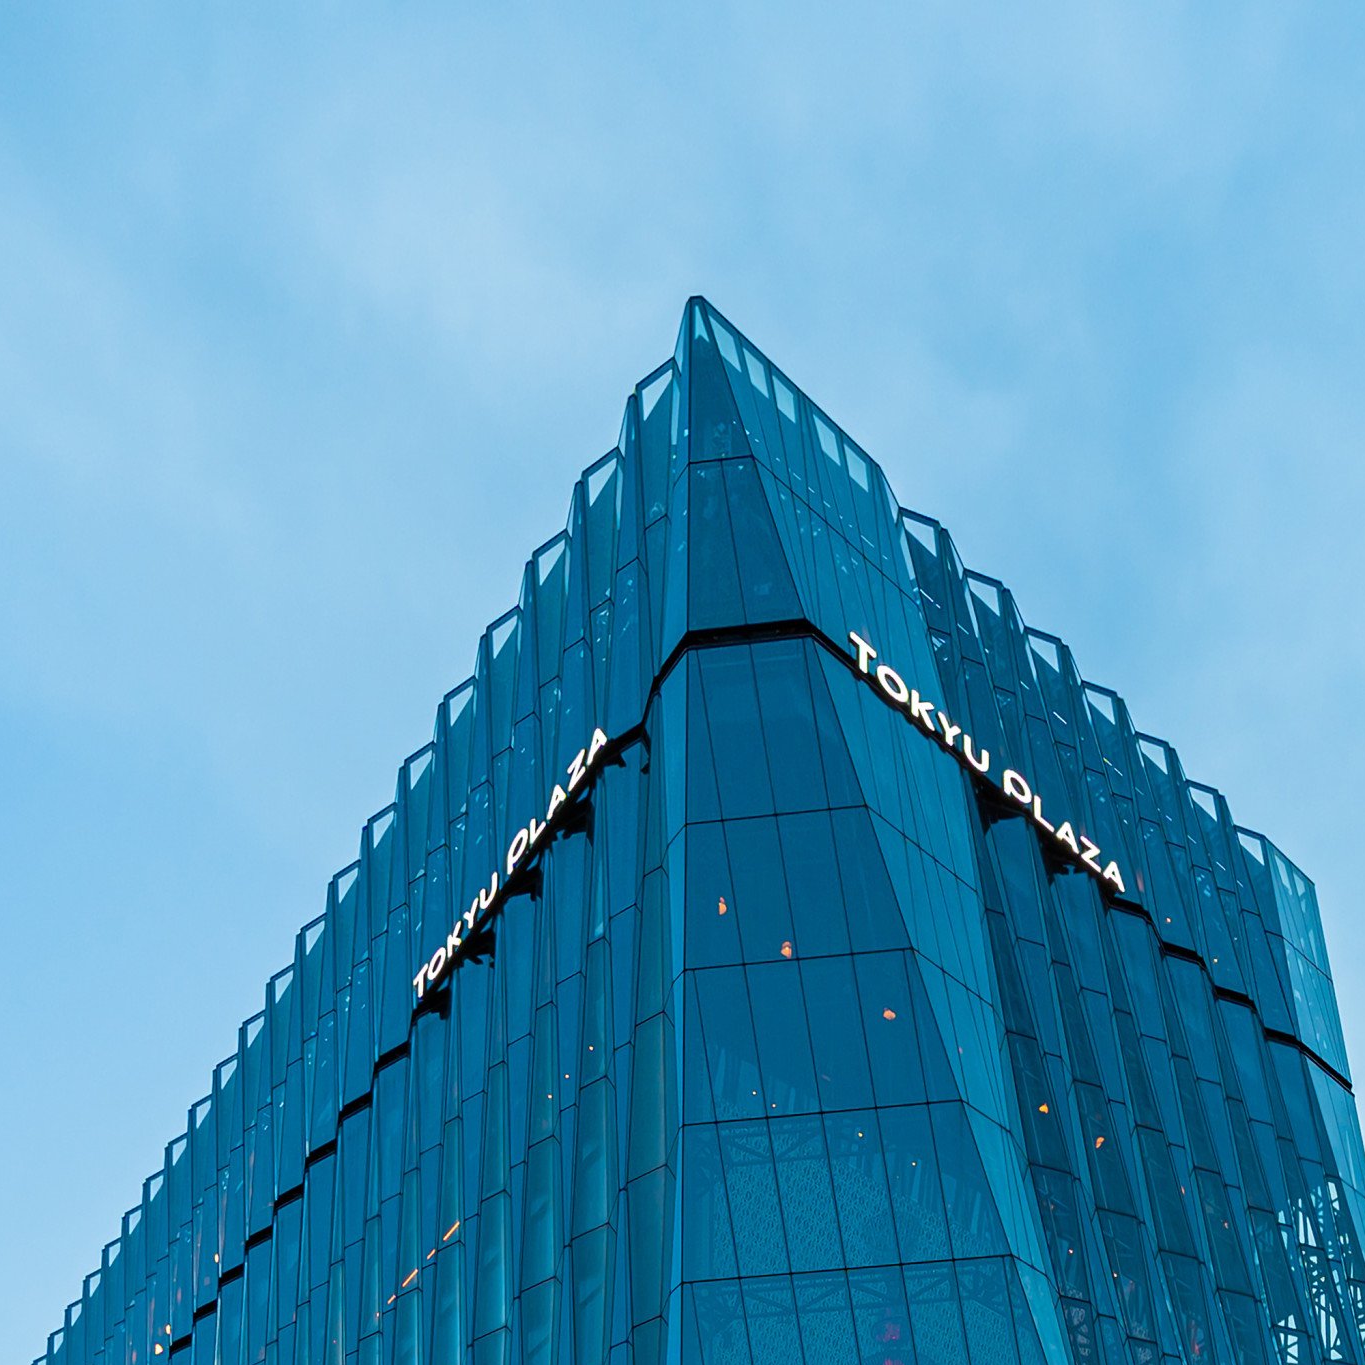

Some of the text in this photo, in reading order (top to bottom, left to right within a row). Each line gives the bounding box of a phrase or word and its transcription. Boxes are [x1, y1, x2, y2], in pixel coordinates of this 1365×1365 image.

[412, 727, 608, 999] TOKYU PLAZA
[849, 631, 1126, 893] TOKYU PLAZA
